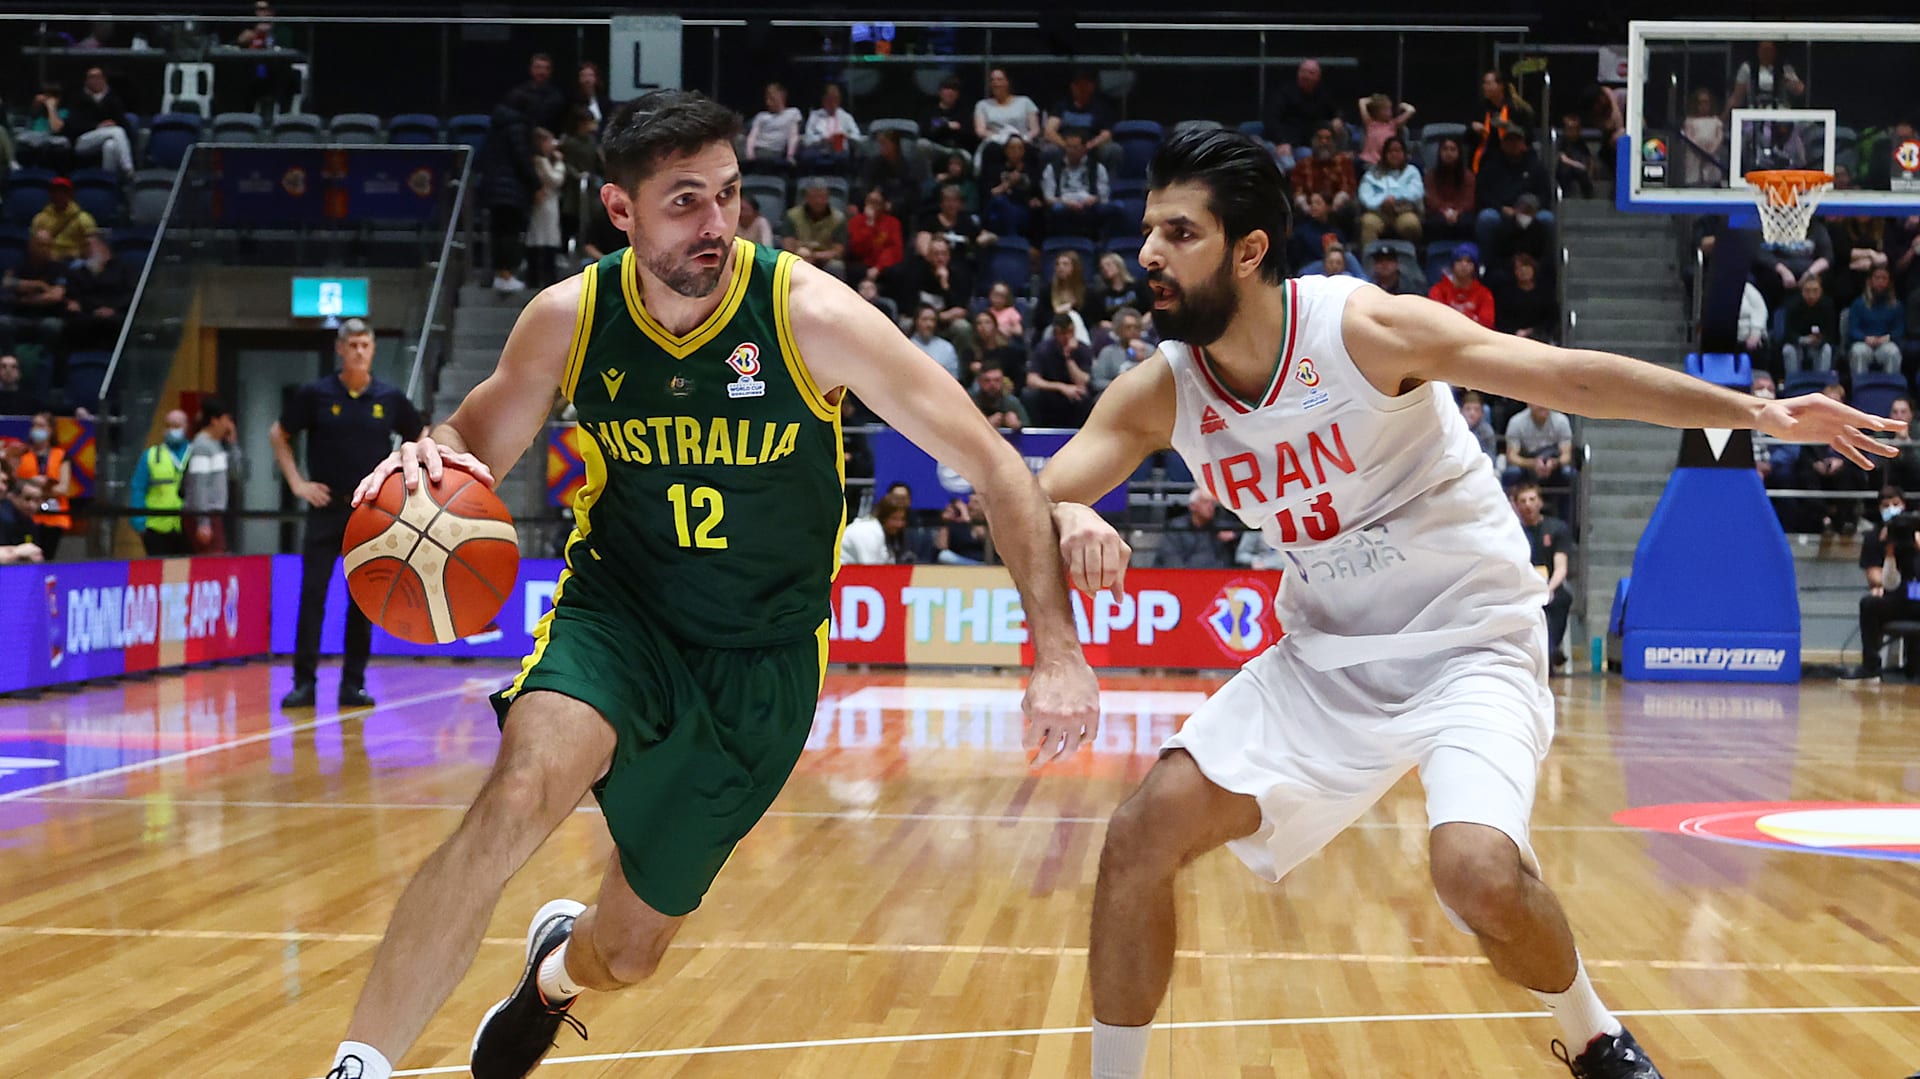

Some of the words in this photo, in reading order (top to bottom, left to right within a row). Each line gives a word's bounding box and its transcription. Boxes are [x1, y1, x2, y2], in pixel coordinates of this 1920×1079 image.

[634, 41, 659, 89] L
[587, 416, 800, 465] USTRALIA
[1201, 422, 1357, 510] IRAN
[666, 483, 728, 549] 12
[1275, 491, 1341, 543] 13
[67, 583, 158, 654] DOWNLOAD
[159, 582, 189, 641] THE
[189, 579, 222, 639] APP
[901, 586, 1029, 644] THE
